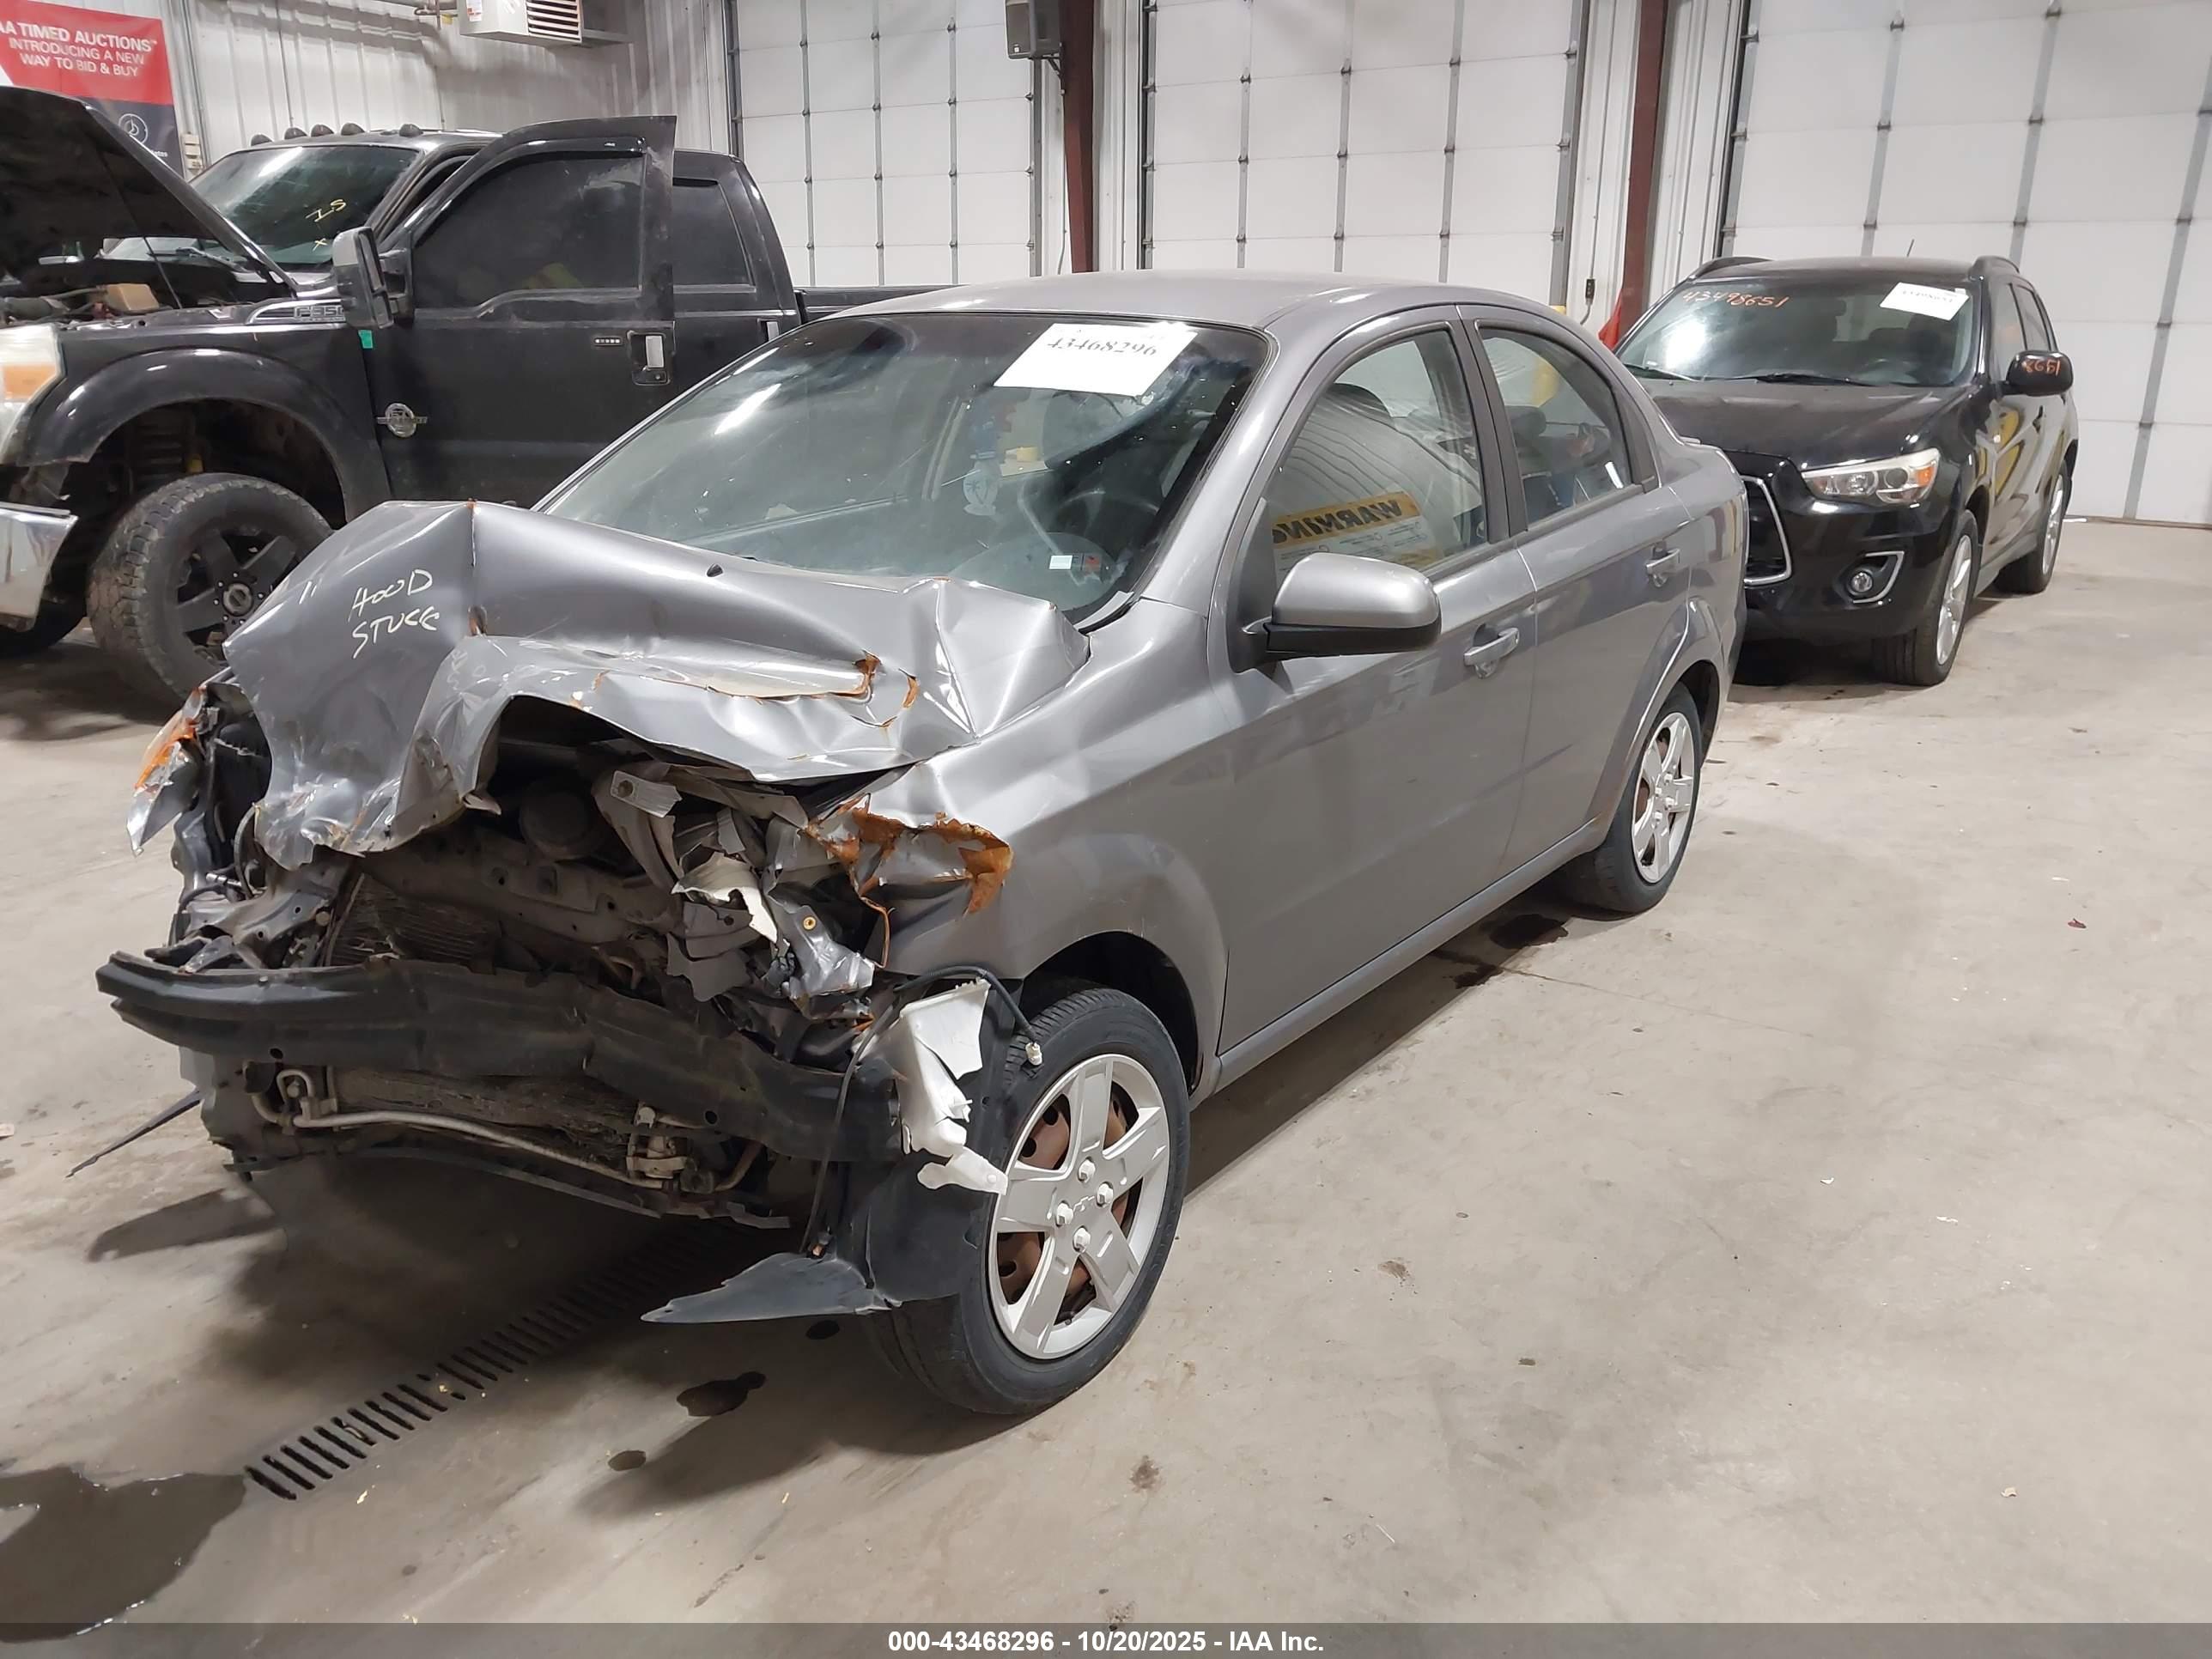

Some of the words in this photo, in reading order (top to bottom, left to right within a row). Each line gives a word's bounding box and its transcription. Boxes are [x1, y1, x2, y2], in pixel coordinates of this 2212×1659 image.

[17, 22, 70, 41] TIMED
[9, 37, 100, 59] INTRODUCING
[104, 50, 113, 61] A
[115, 51, 144, 64] NEW
[20, 52, 51, 67] WAY
[54, 56, 73, 70] TO
[76, 59, 97, 73] BID
[100, 63, 110, 75] &
[112, 64, 138, 77] BUY
[1047, 337, 1158, 357] 43468296
[348, 569, 433, 623] HOOD
